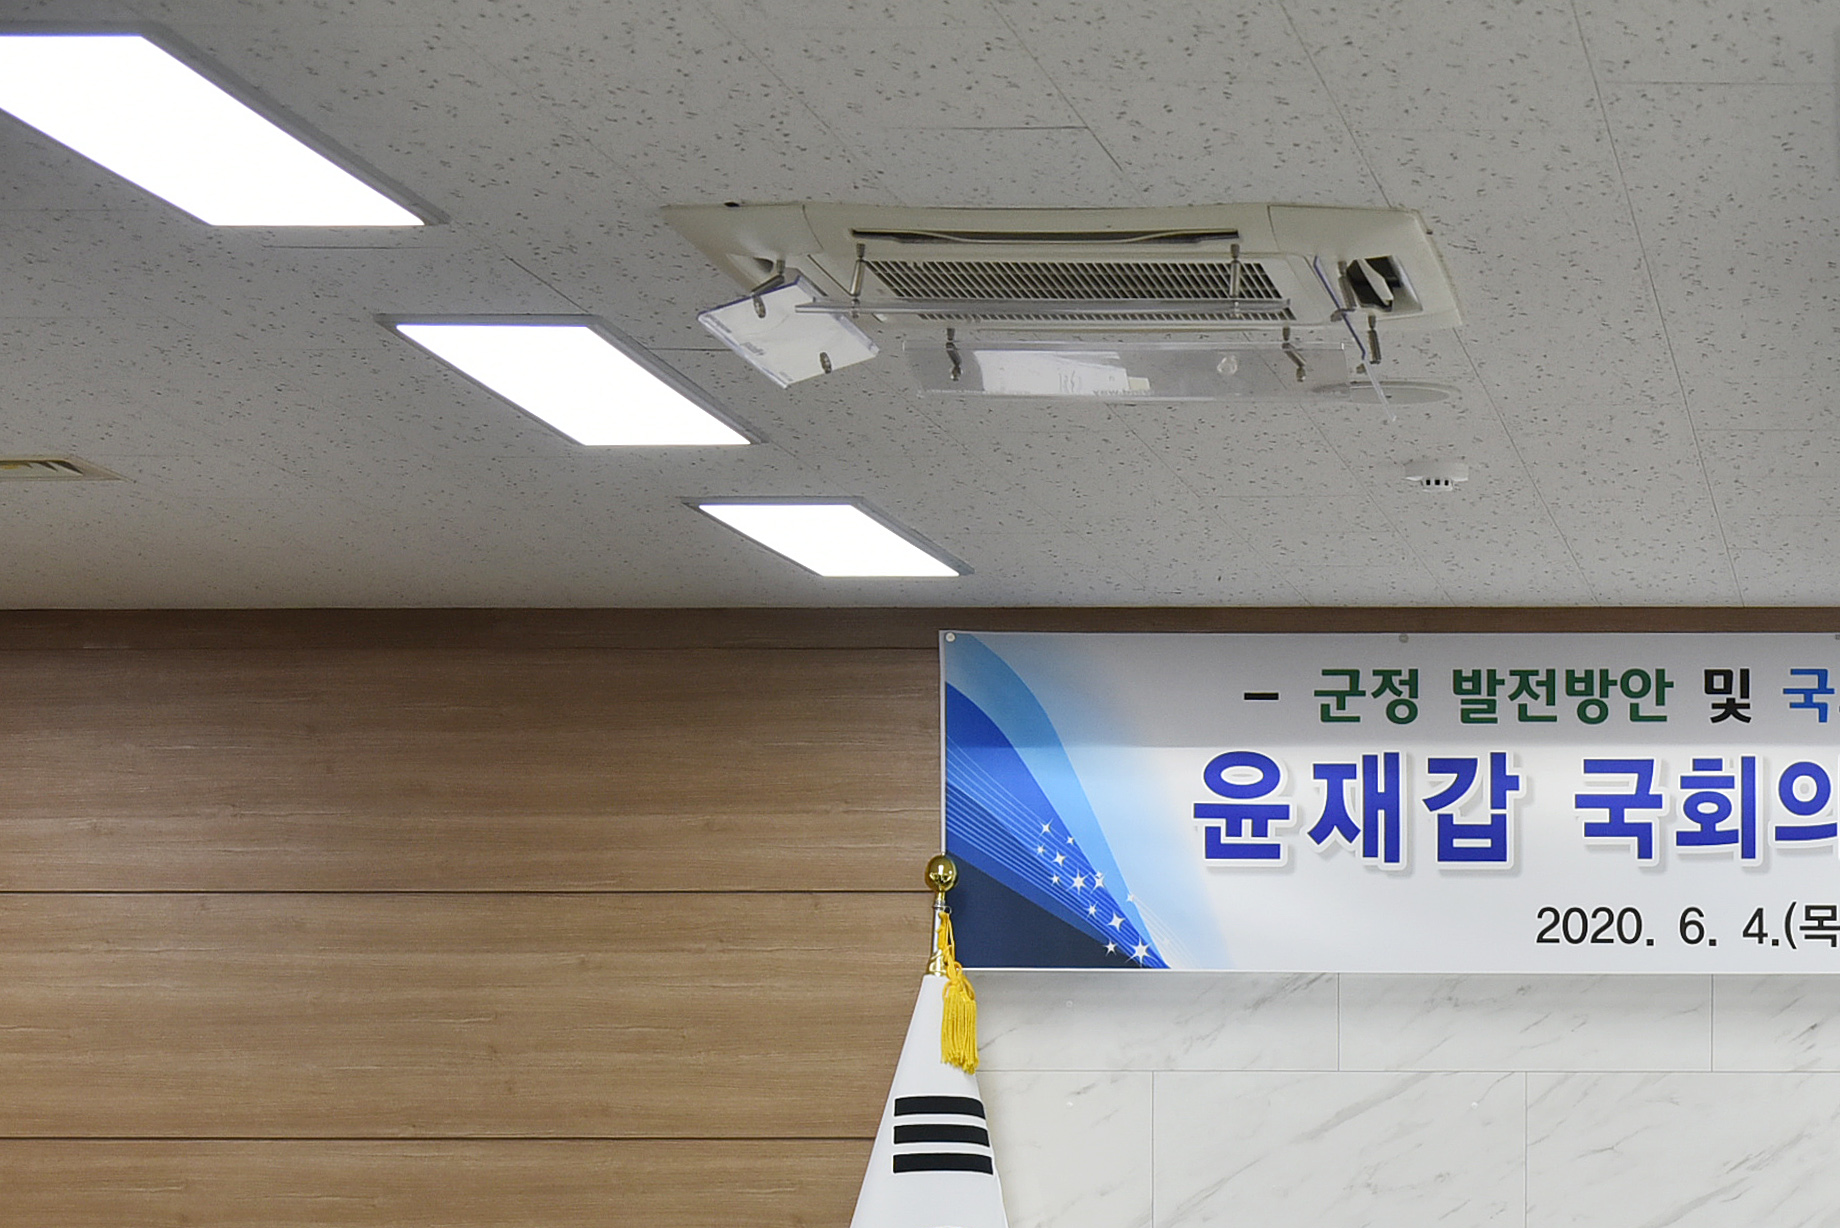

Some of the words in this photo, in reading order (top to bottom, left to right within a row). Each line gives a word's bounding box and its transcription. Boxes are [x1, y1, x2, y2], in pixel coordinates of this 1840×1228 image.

[1313, 668, 1419, 725] 군정
[1452, 668, 1675, 725] 발전방안
[1703, 667, 1752, 724] 및
[1193, 750, 1520, 863] 윤재갑
[1536, 906, 1655, 947] 2020.
[1679, 907, 1717, 947] 6.
